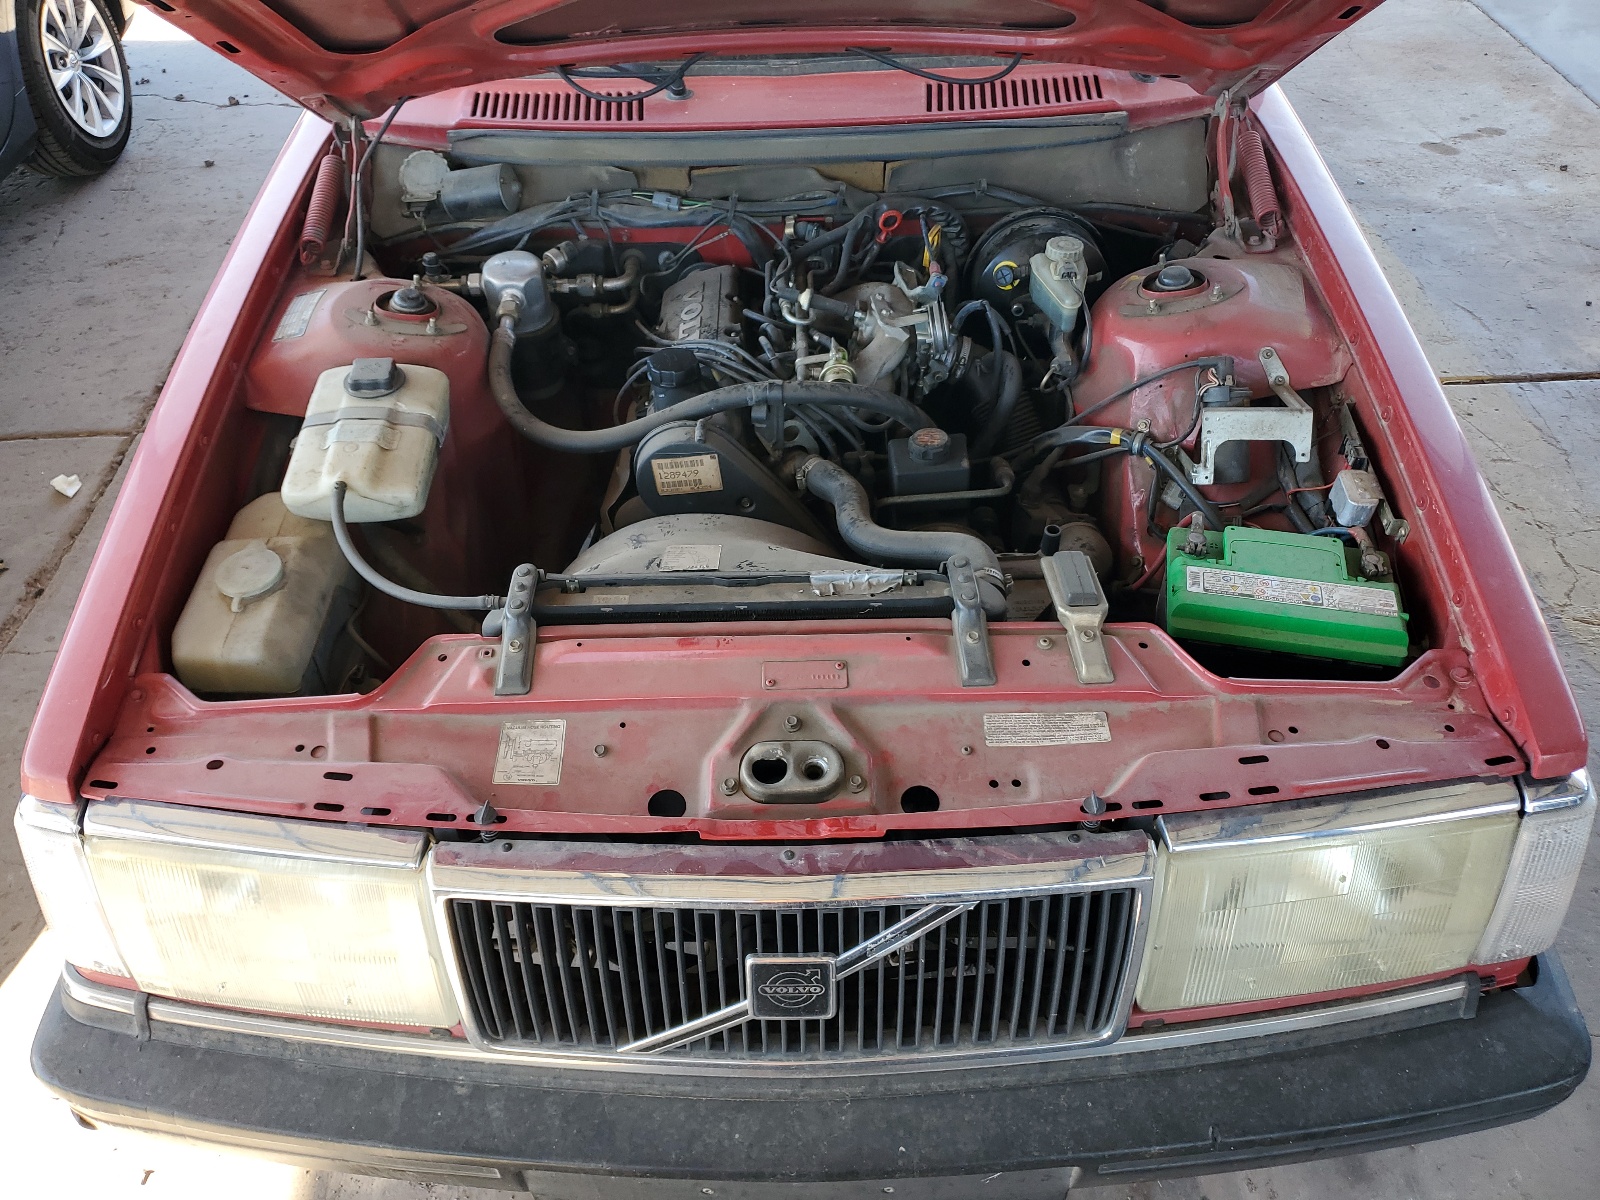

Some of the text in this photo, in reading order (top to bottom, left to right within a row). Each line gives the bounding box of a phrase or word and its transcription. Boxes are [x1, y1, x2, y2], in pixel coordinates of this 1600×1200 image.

[678, 281, 706, 340] VOL
[658, 469, 700, 480] 1289479
[762, 986, 821, 994] VOLVO
